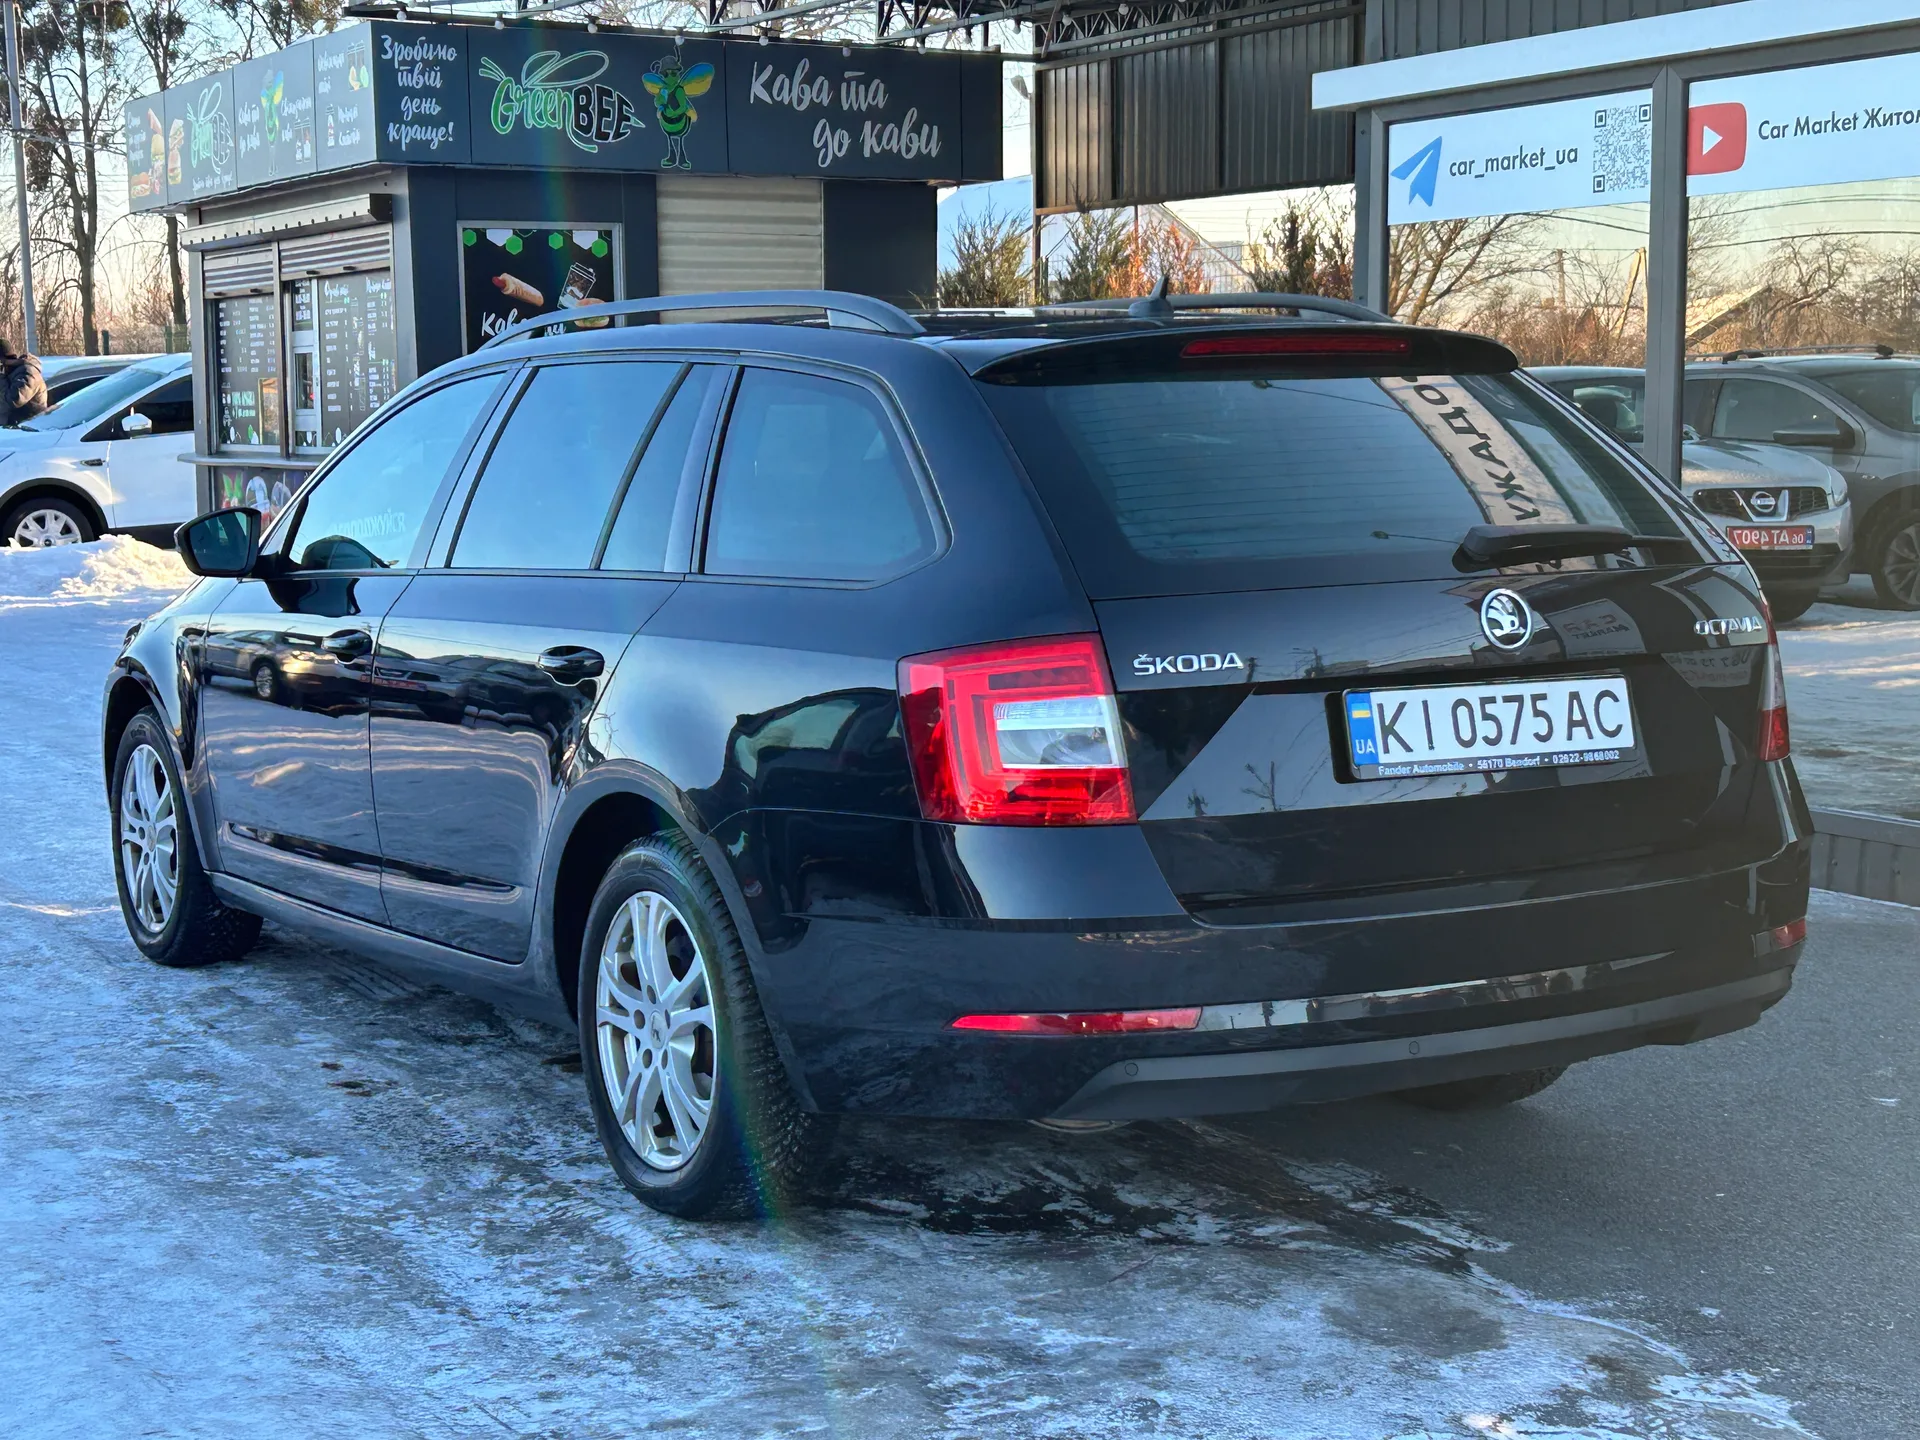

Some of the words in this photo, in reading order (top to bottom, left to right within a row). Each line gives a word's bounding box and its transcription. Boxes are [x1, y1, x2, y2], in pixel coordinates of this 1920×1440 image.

[381, 35, 457, 69] Зробимо
[397, 62, 443, 88] твій
[750, 58, 833, 111] Кава
[840, 71, 888, 111] та
[401, 96, 442, 121] день
[387, 122, 454, 151] краще!
[812, 118, 851, 167] до
[859, 107, 941, 159] кави
[1758, 119, 1789, 140] Car
[1793, 110, 1859, 137] Market
[1449, 145, 1578, 179] car_market_ua
[1694, 616, 1762, 635] OCTAVIA
[1133, 652, 1244, 676] ŠKODA
[1376, 700, 1435, 754] KI
[1451, 693, 1554, 749] 0575
[1566, 689, 1623, 741] AC
[1356, 739, 1375, 754] UA
